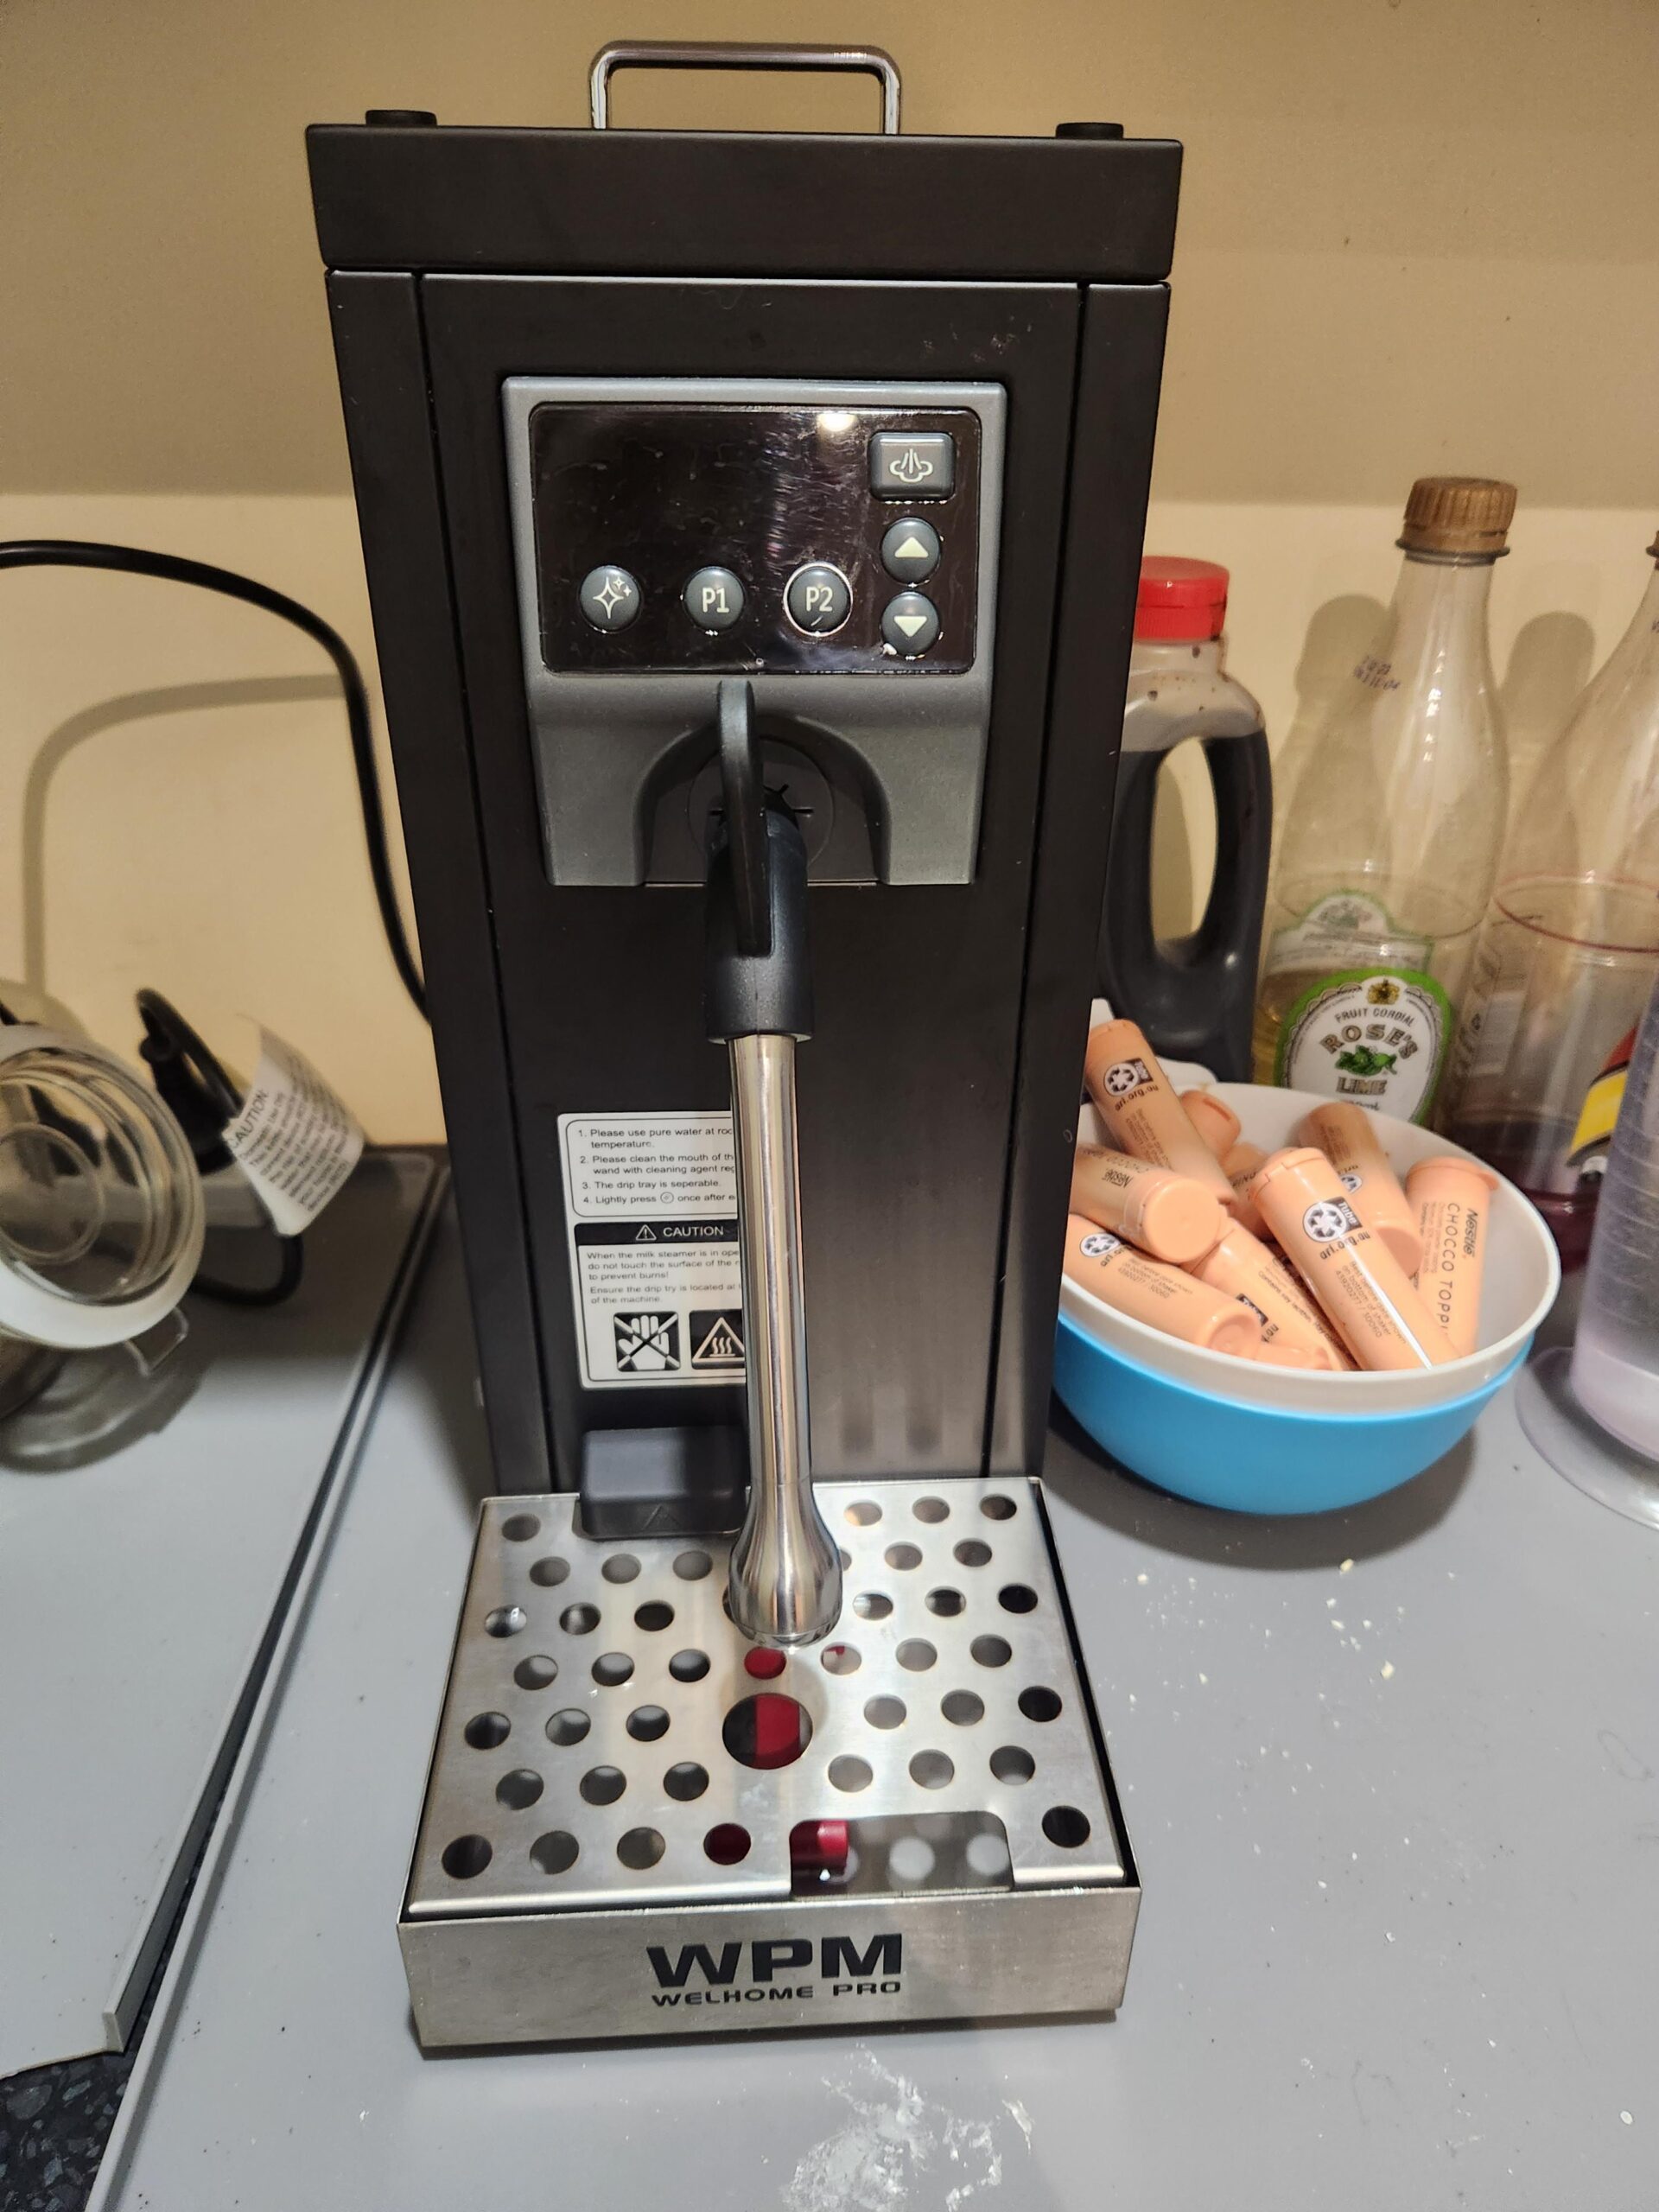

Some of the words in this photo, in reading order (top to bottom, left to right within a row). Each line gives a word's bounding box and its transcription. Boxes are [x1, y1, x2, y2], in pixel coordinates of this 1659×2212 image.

[702, 588, 729, 613] P1
[806, 587, 833, 612] P2
[1334, 1008, 1368, 1023] FRUIT
[1373, 1008, 1415, 1027] CORDIAL
[1319, 1024, 1418, 1059] ROSE'S
[1337, 1077, 1388, 1095] LIME
[646, 1166, 687, 1174] cleaning
[690, 1166, 718, 1174] agent
[595, 1196, 627, 1205] Lightly
[664, 1226, 724, 1236] CAUTION
[1442, 1202, 1460, 1272] CHOCCO
[1463, 1208, 1478, 1258] Nestlé
[645, 1285, 661, 1294] drip
[1349, 1275, 1370, 1304] bottom
[646, 1933, 902, 1988] WPM
[652, 1986, 813, 2007] WELHOME
[833, 1981, 901, 1997] PRO
